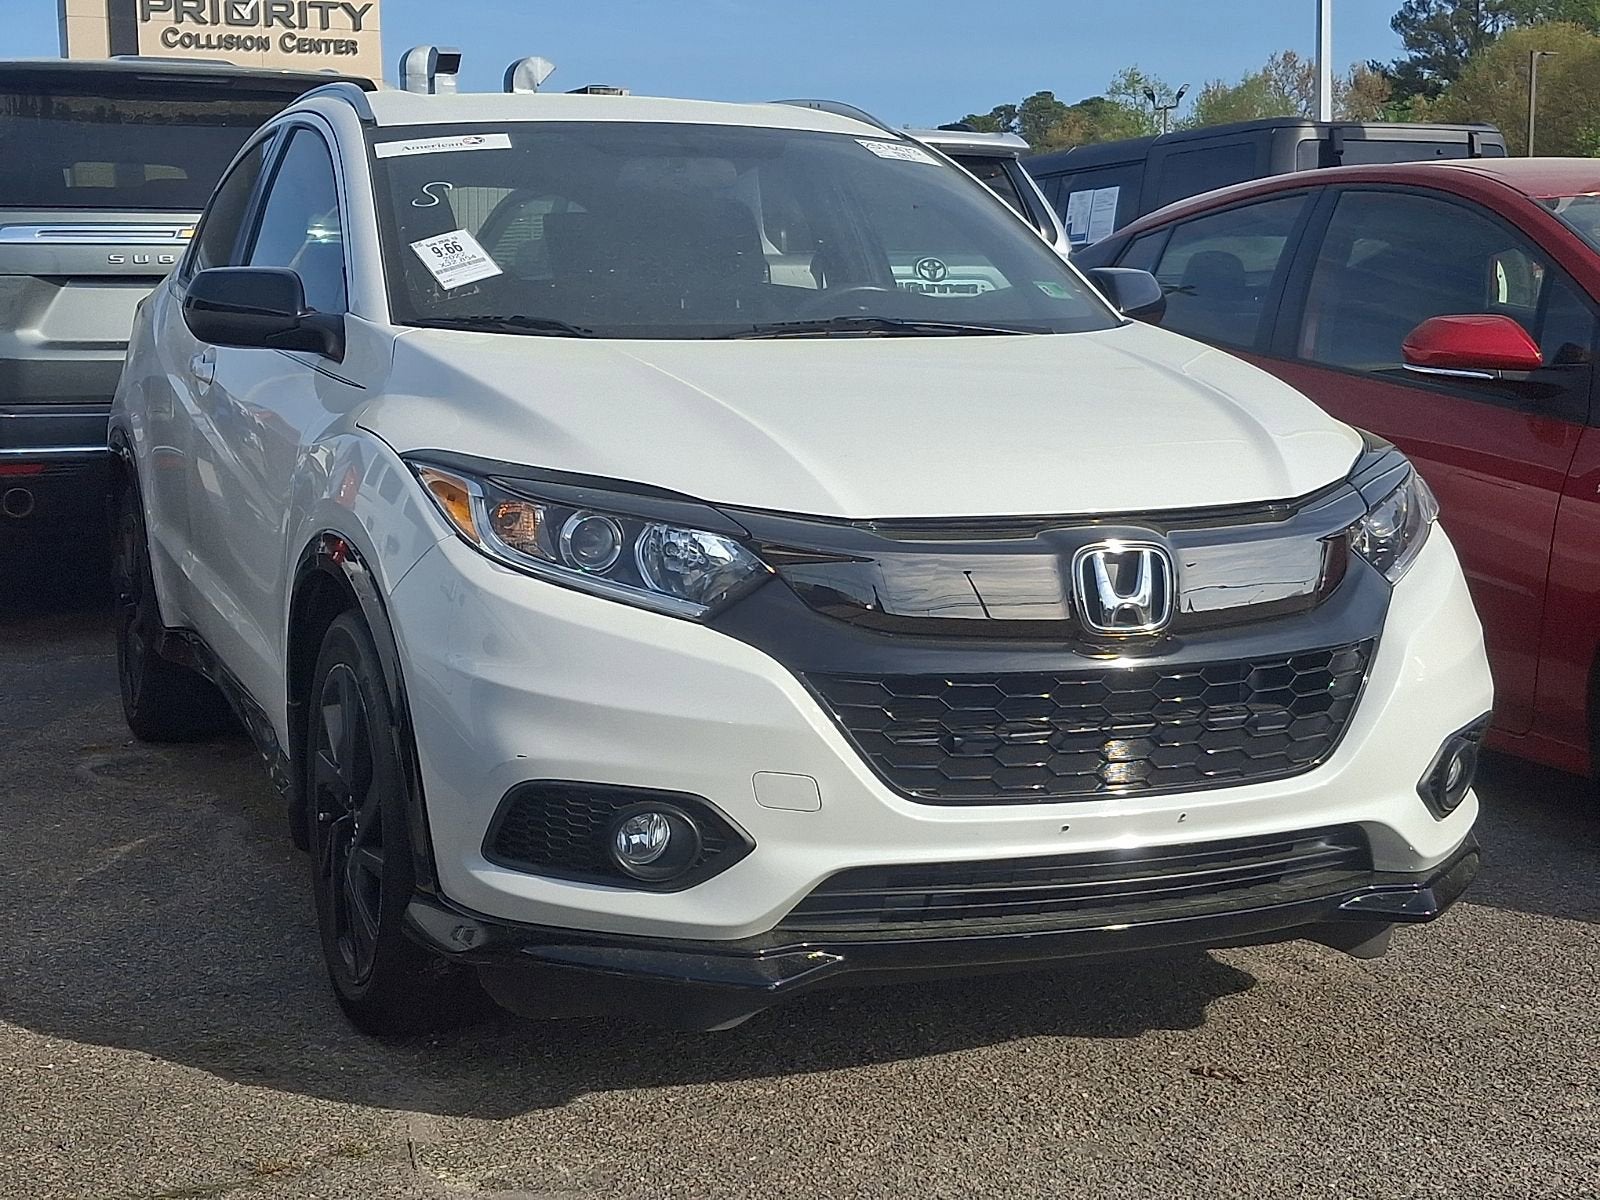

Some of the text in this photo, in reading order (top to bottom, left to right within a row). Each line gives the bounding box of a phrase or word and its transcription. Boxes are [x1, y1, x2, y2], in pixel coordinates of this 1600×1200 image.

[140, 0, 374, 31] PRIORITY
[161, 27, 358, 56] COLLISION CENTER
[431, 240, 463, 258] 9:66
